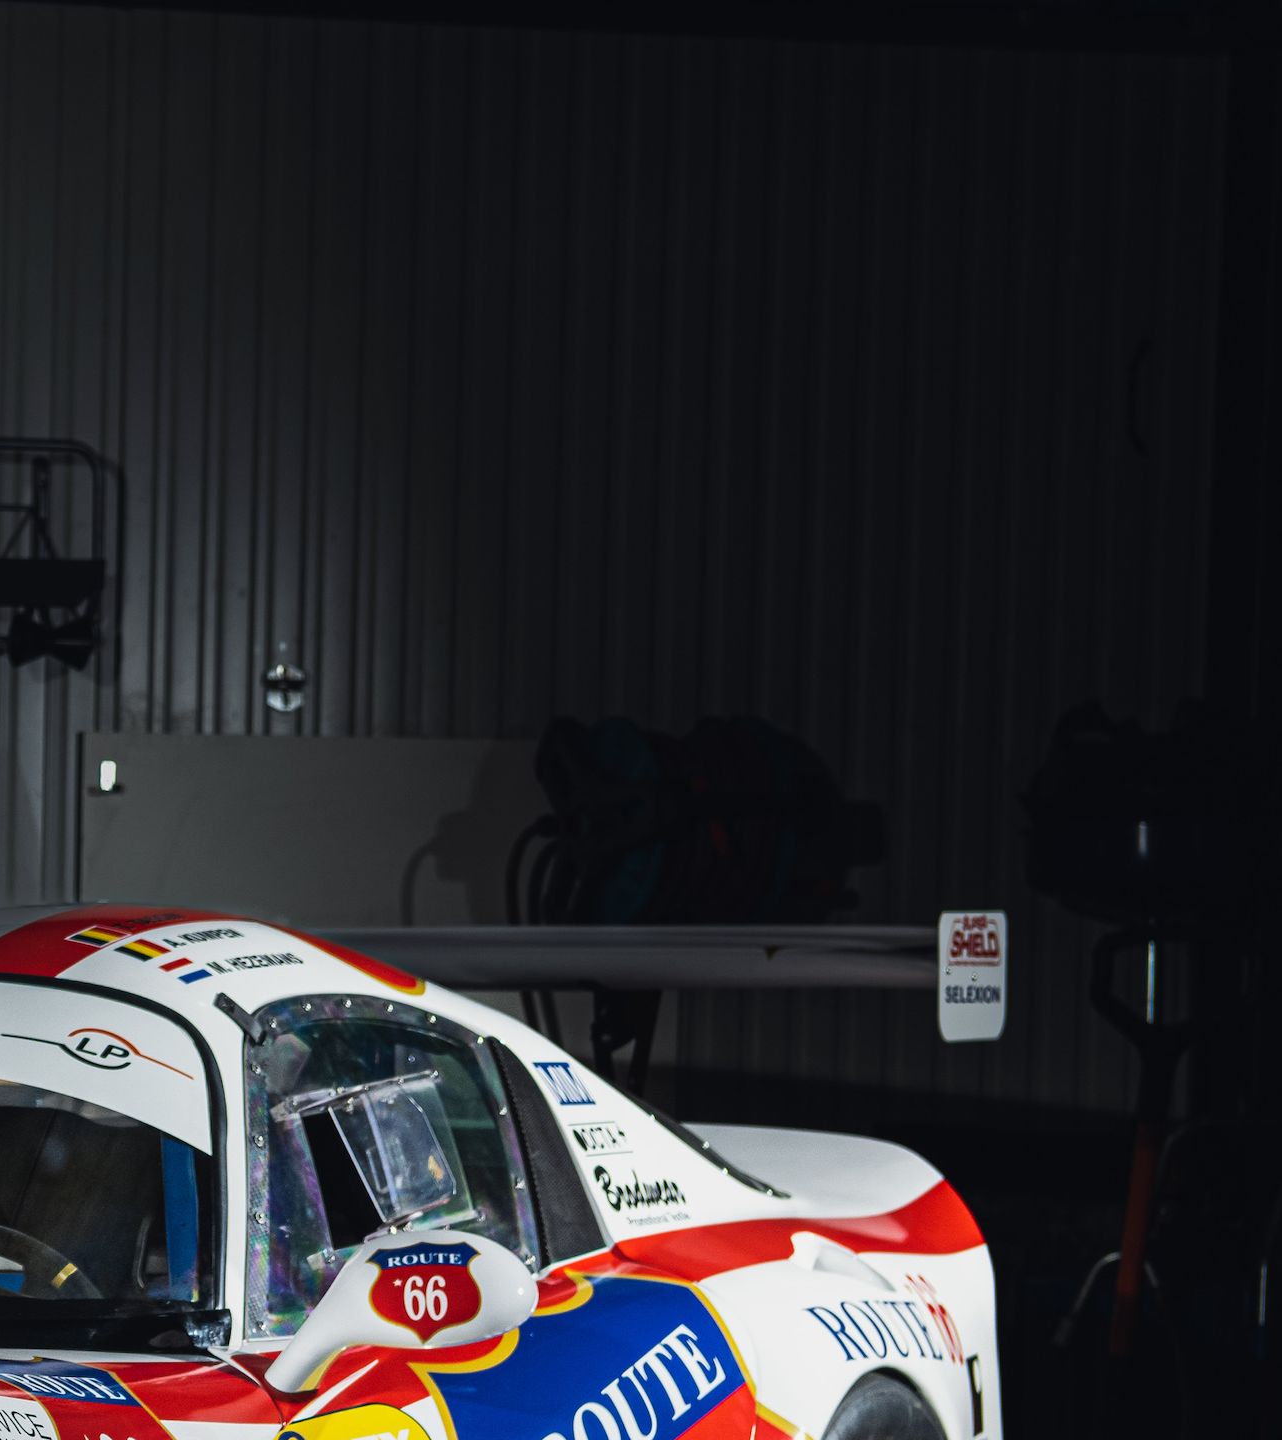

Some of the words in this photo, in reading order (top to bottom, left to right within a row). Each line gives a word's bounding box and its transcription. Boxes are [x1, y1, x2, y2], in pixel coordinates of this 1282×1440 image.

[944, 985, 1001, 1004] SELEXION
[74, 1034, 130, 1061] LP
[387, 1252, 462, 1268] ROUTE
[403, 1275, 448, 1321] 66
[802, 1301, 943, 1361] ROUTE
[0, 1373, 127, 1400] ROUTE
